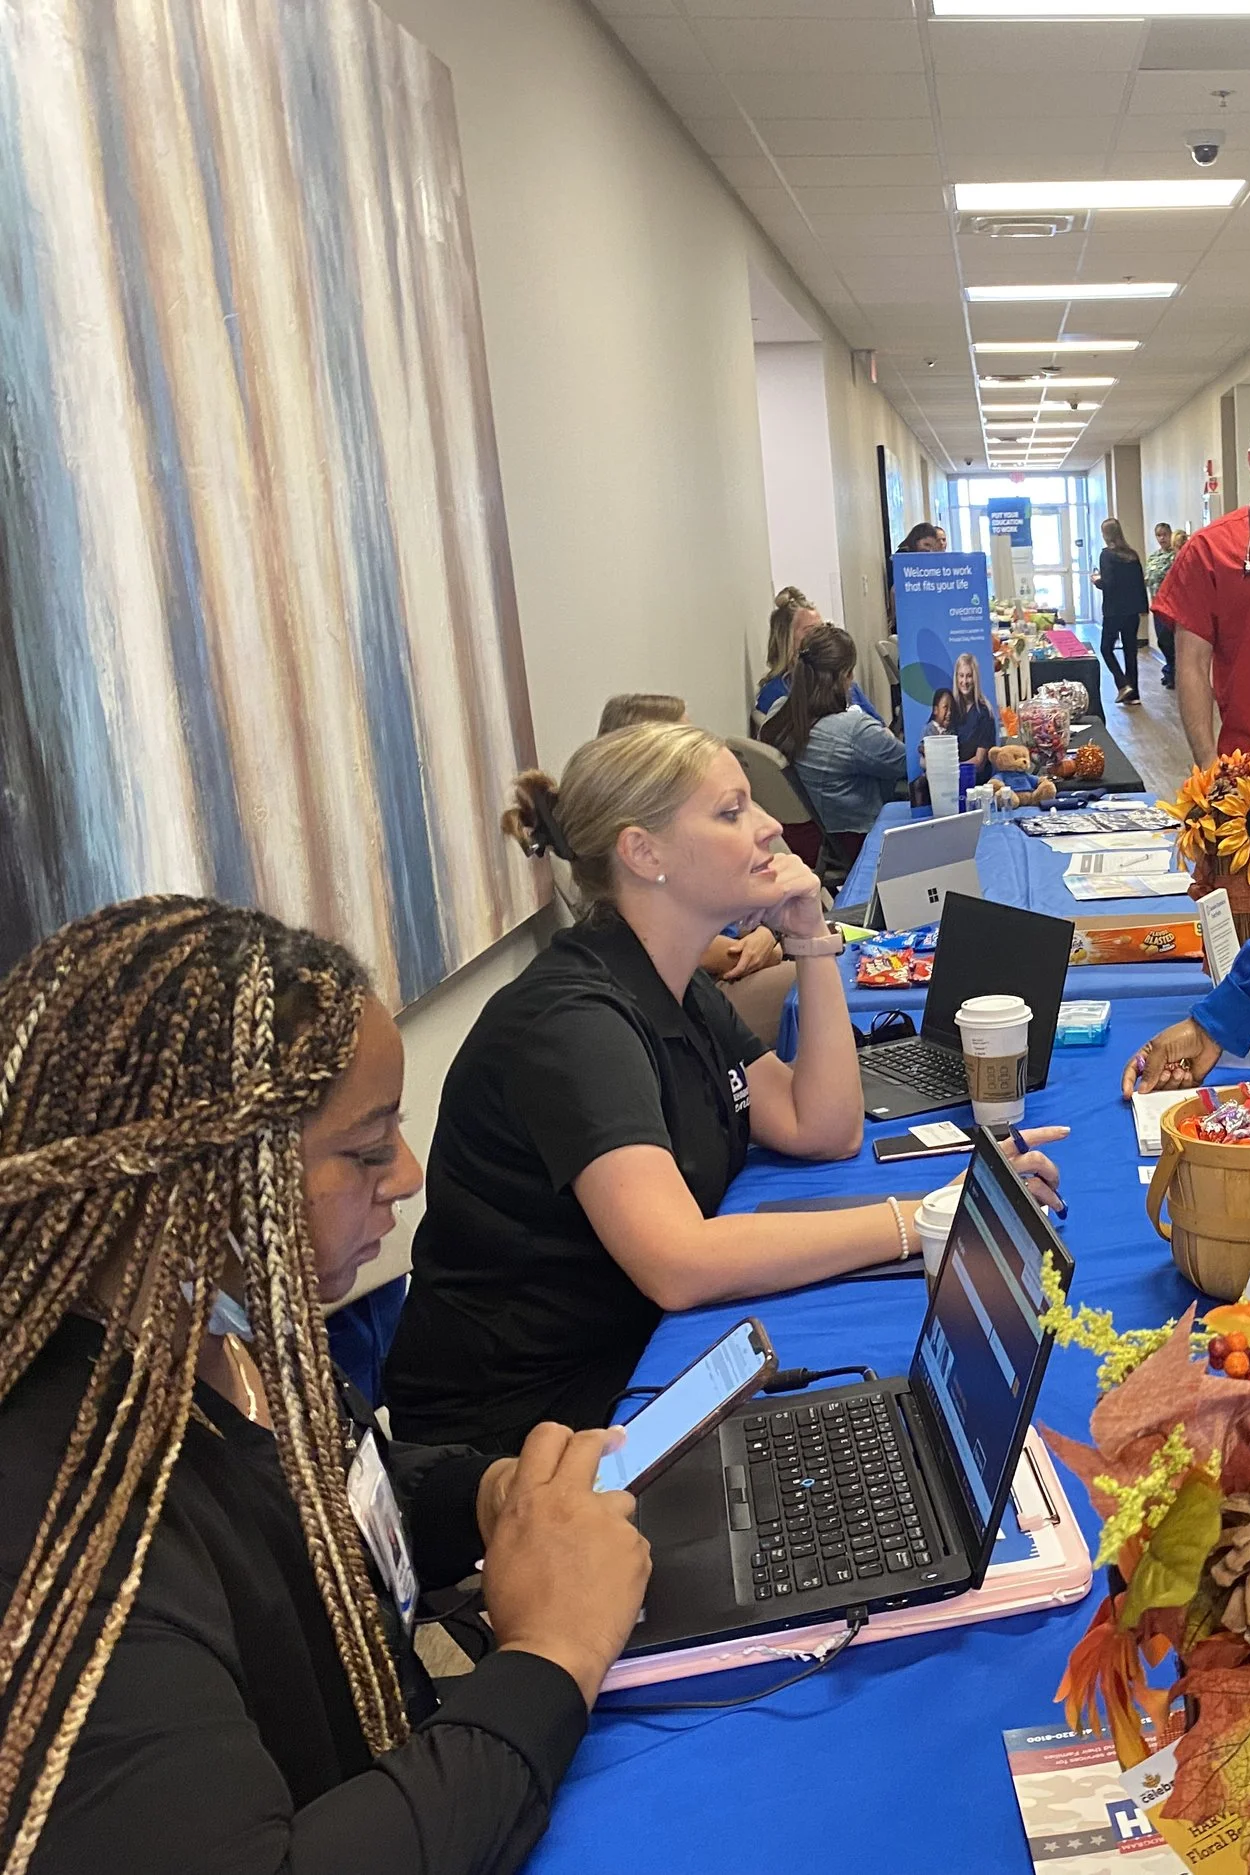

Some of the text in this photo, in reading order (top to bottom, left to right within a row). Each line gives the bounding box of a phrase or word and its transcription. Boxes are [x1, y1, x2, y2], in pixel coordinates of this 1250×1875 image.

[903, 565, 972, 578] Welcome to work
[905, 579, 968, 593] that fits your life
[949, 606, 983, 616] aveanna
[1144, 933, 1175, 945] BLASTED
[1186, 1835, 1229, 1864] Floral
